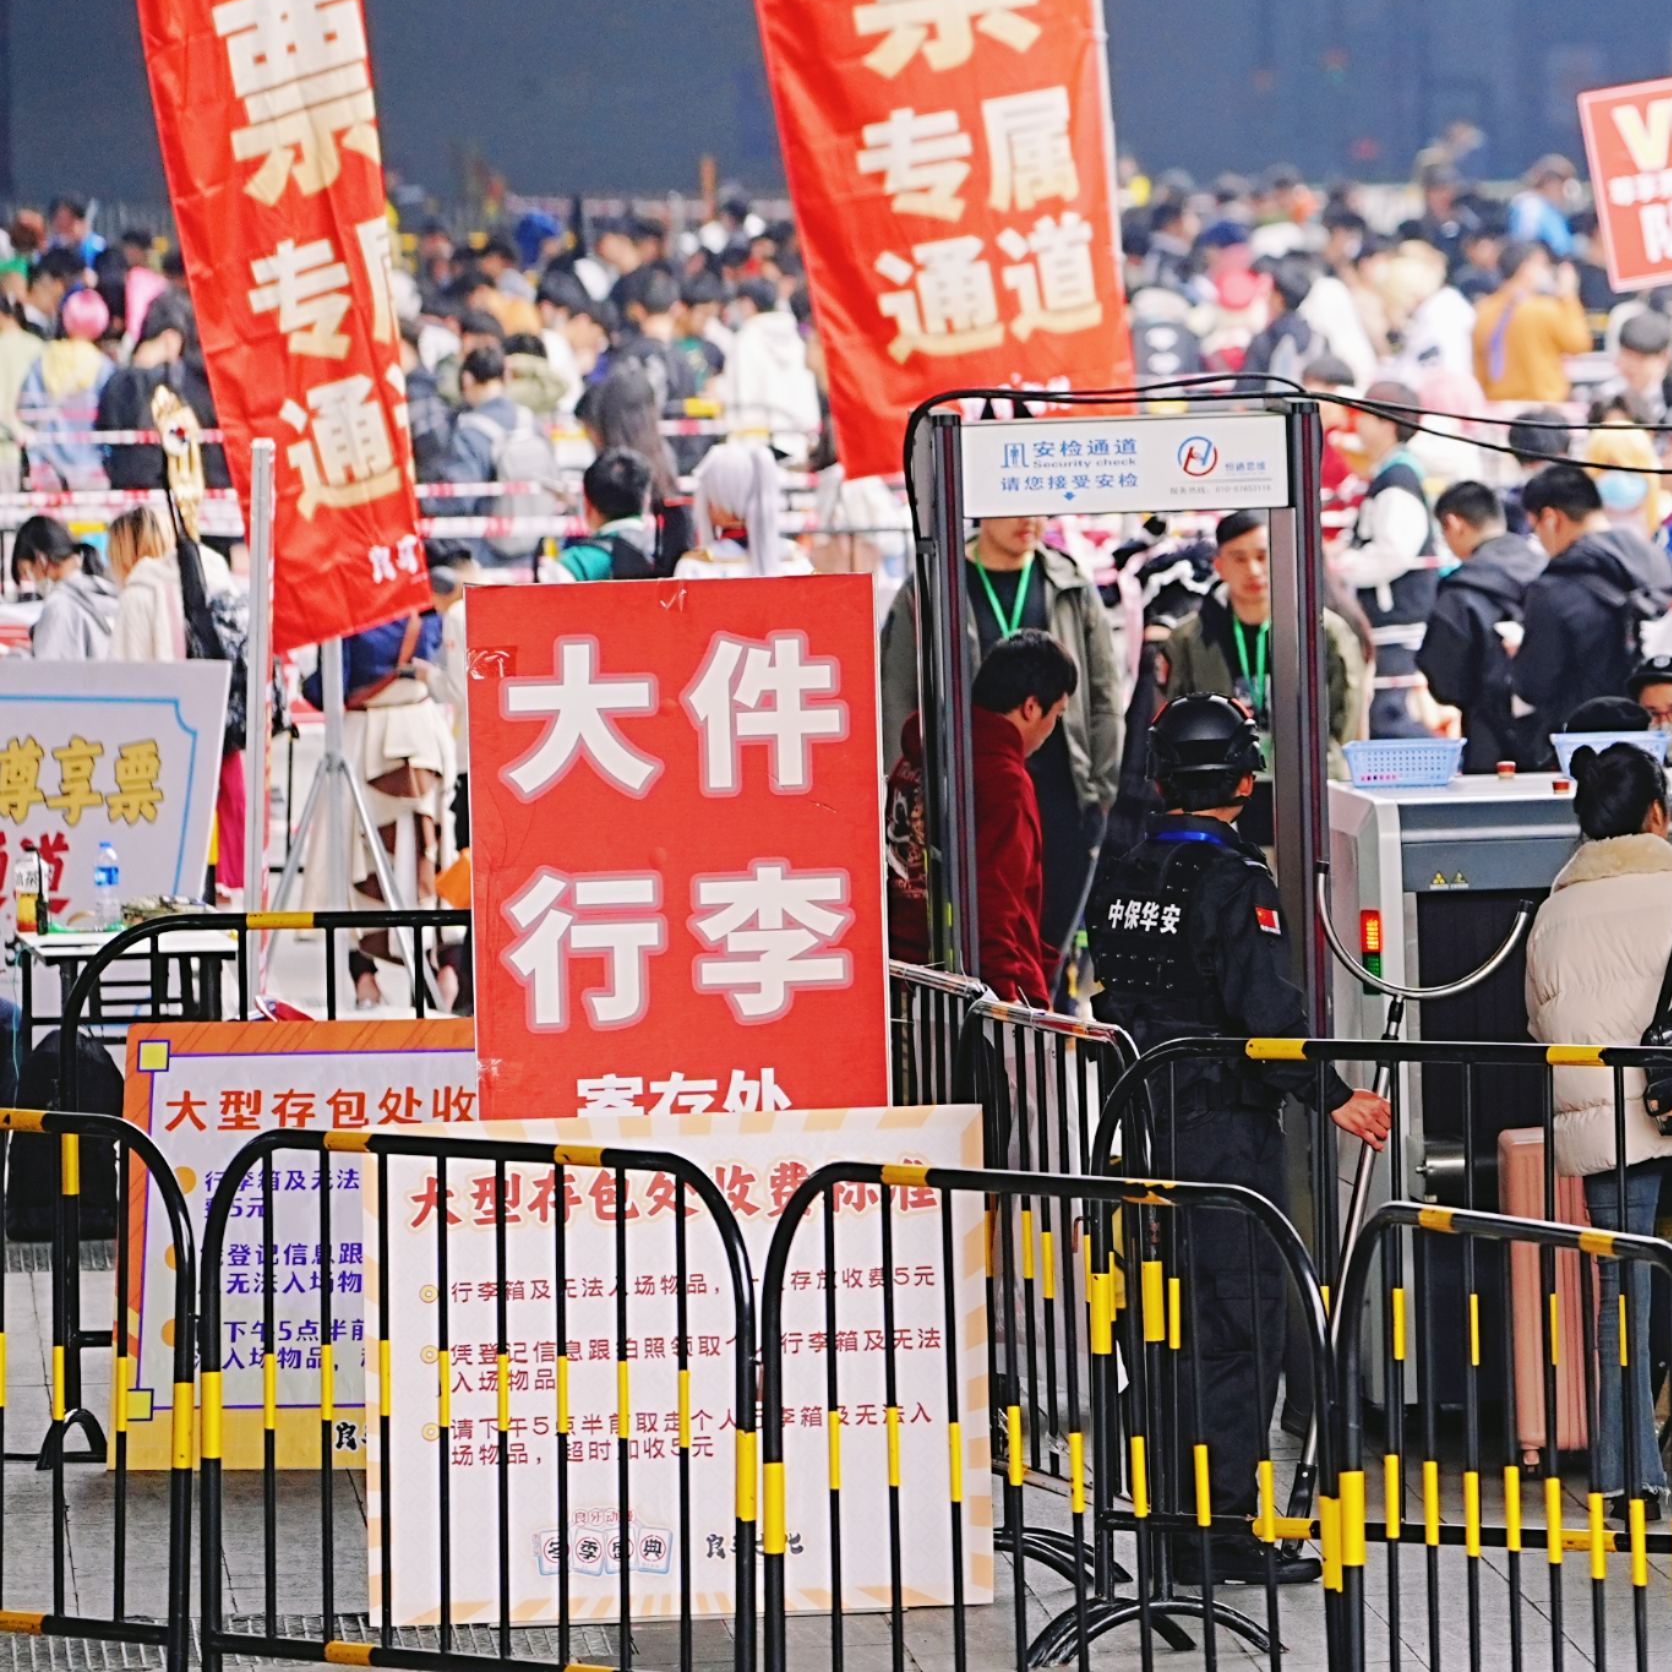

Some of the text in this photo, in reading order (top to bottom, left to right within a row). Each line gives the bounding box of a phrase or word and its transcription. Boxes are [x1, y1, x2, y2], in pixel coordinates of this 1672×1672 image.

[857, 85, 1079, 225] 专属
[878, 211, 1103, 364] 通道
[278, 362, 412, 520] 通
[1033, 438, 1137, 458] 安检通道
[1033, 457, 1137, 469] Security check
[1000, 474, 1139, 492] 请您接受安检
[507, 638, 842, 795] 大件
[0, 734, 164, 826] 尊享票
[0, 830, 70, 916] 道
[1108, 899, 1182, 935] 中保华安
[509, 865, 846, 1025] 行李
[165, 1088, 476, 1132] 大型存包处收
[218, 1242, 363, 1268] 登记信息跟
[451, 1368, 557, 1394] 入场物品
[334, 1421, 367, 1451] 良
